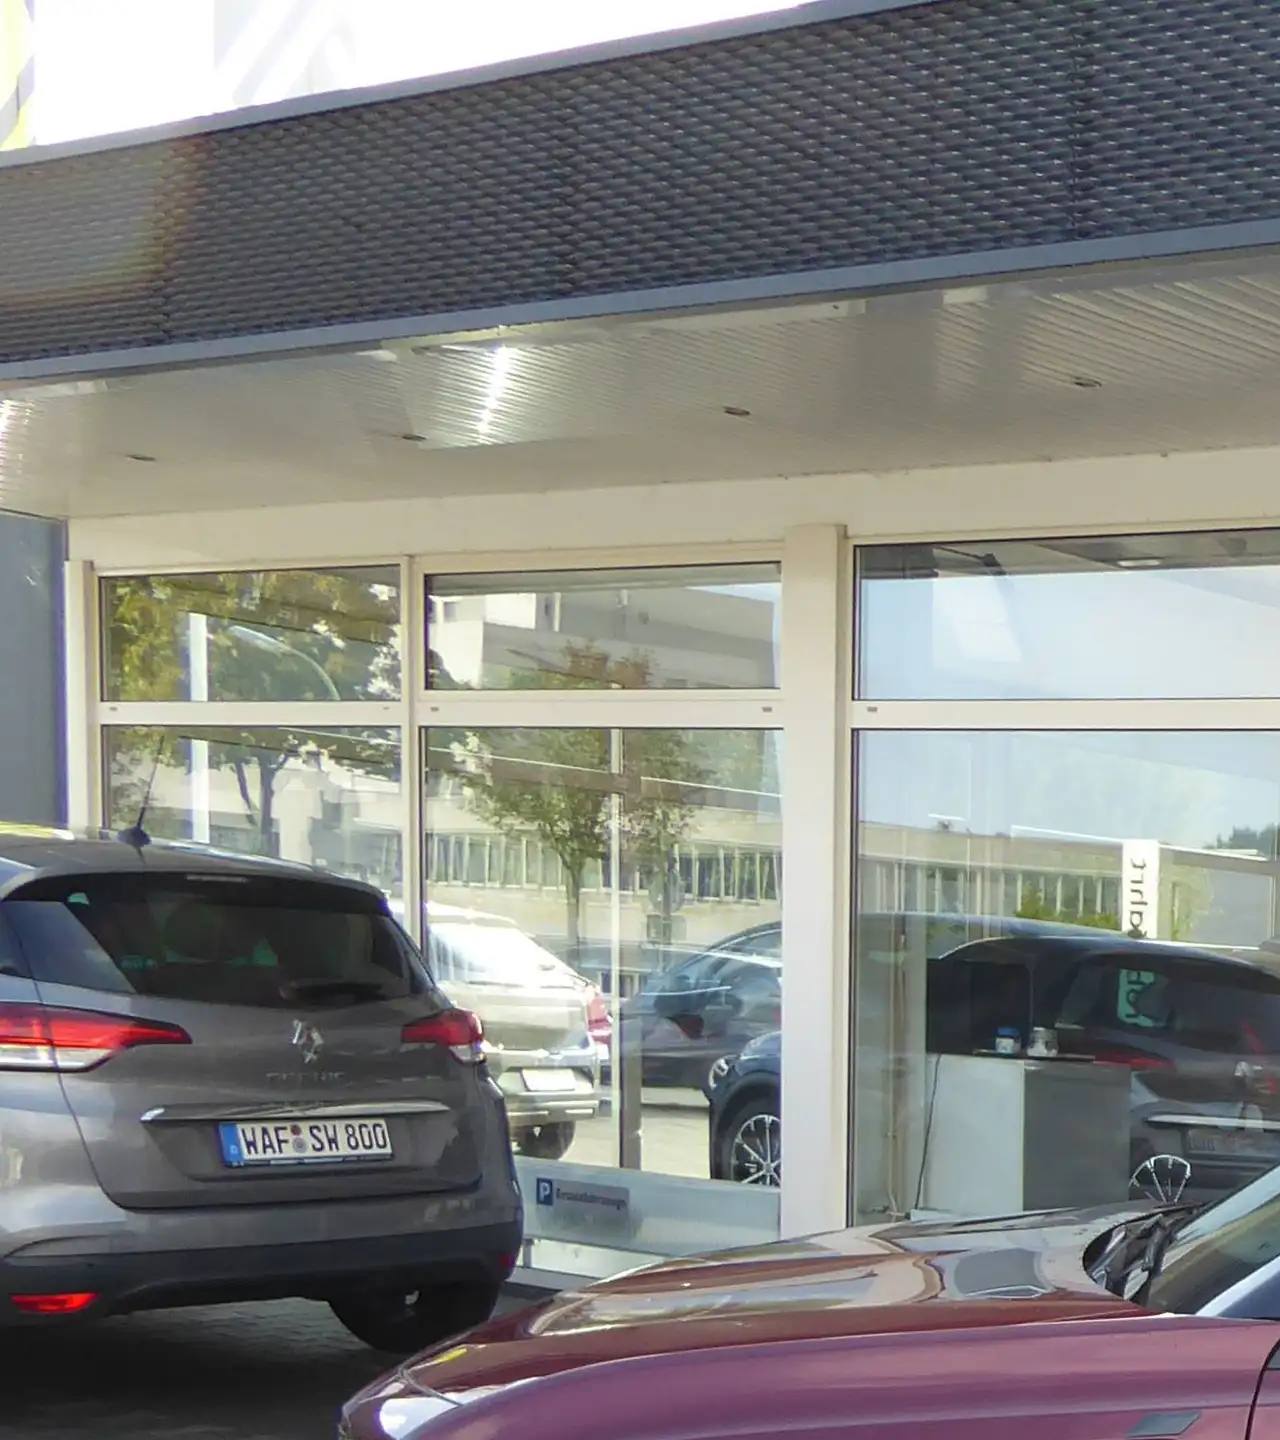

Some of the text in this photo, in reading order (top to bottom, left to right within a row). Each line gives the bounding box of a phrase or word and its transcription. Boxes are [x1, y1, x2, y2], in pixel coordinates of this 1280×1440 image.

[242, 1122, 388, 1155] WAF SW 800
